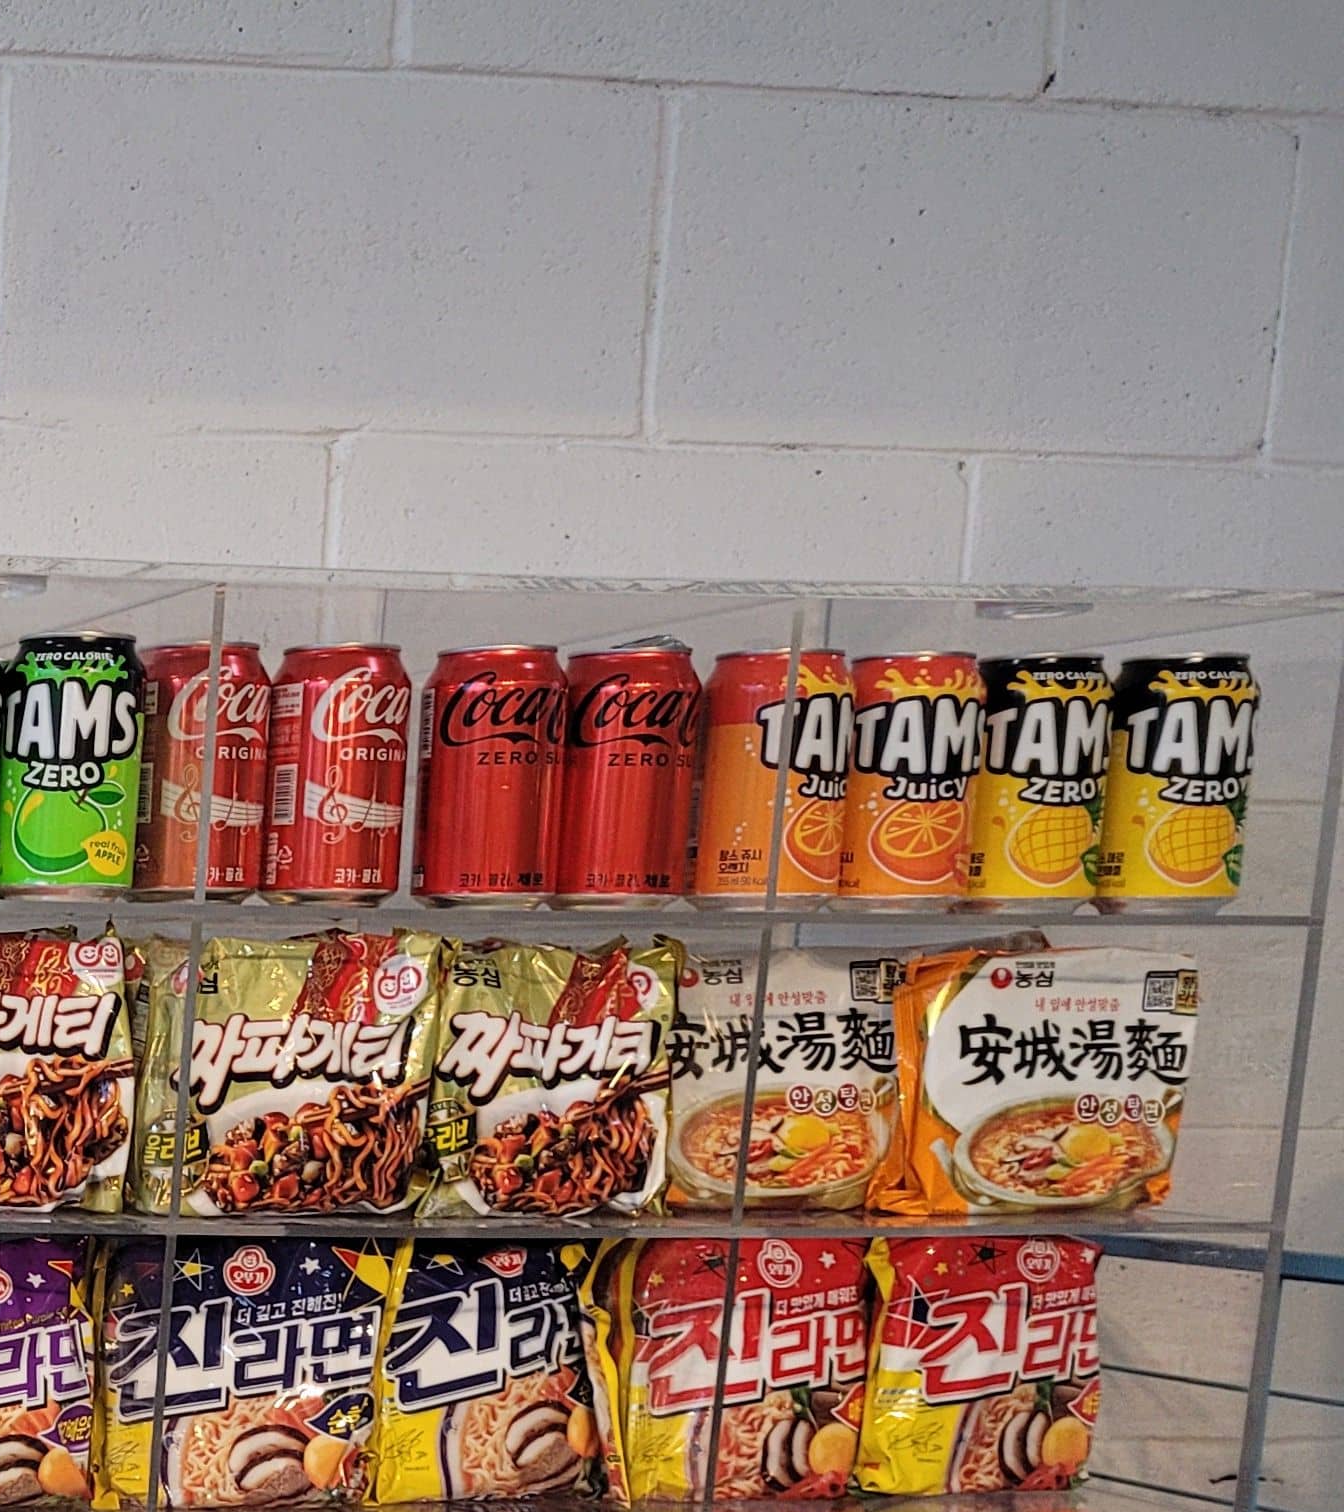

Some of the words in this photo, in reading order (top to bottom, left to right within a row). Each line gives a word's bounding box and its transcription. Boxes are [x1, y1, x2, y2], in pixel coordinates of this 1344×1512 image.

[35, 651, 62, 662] ZERO
[8, 678, 137, 759] TAMS
[477, 752, 538, 766] ZERO
[608, 752, 670, 767] ZERO
[23, 762, 101, 789] ZERO
[887, 776, 967, 801] Juicy
[1021, 777, 1097, 804] ZERO
[1161, 777, 1240, 804] ZERO
[454, 961, 502, 988] 농심
[701, 965, 745, 985] 농심
[1015, 968, 1054, 988] 농심
[667, 1007, 898, 1081] 安城湯麵
[959, 1014, 1190, 1086] 安城湯麵
[171, 1013, 411, 1111] 짜파게티
[1074, 1093, 1166, 1125] 안성탕면
[236, 1306, 252, 1324] 더
[255, 1302, 286, 1321] 깊고
[291, 1294, 343, 1319] 진해진!
[112, 1296, 382, 1422] 진라면
